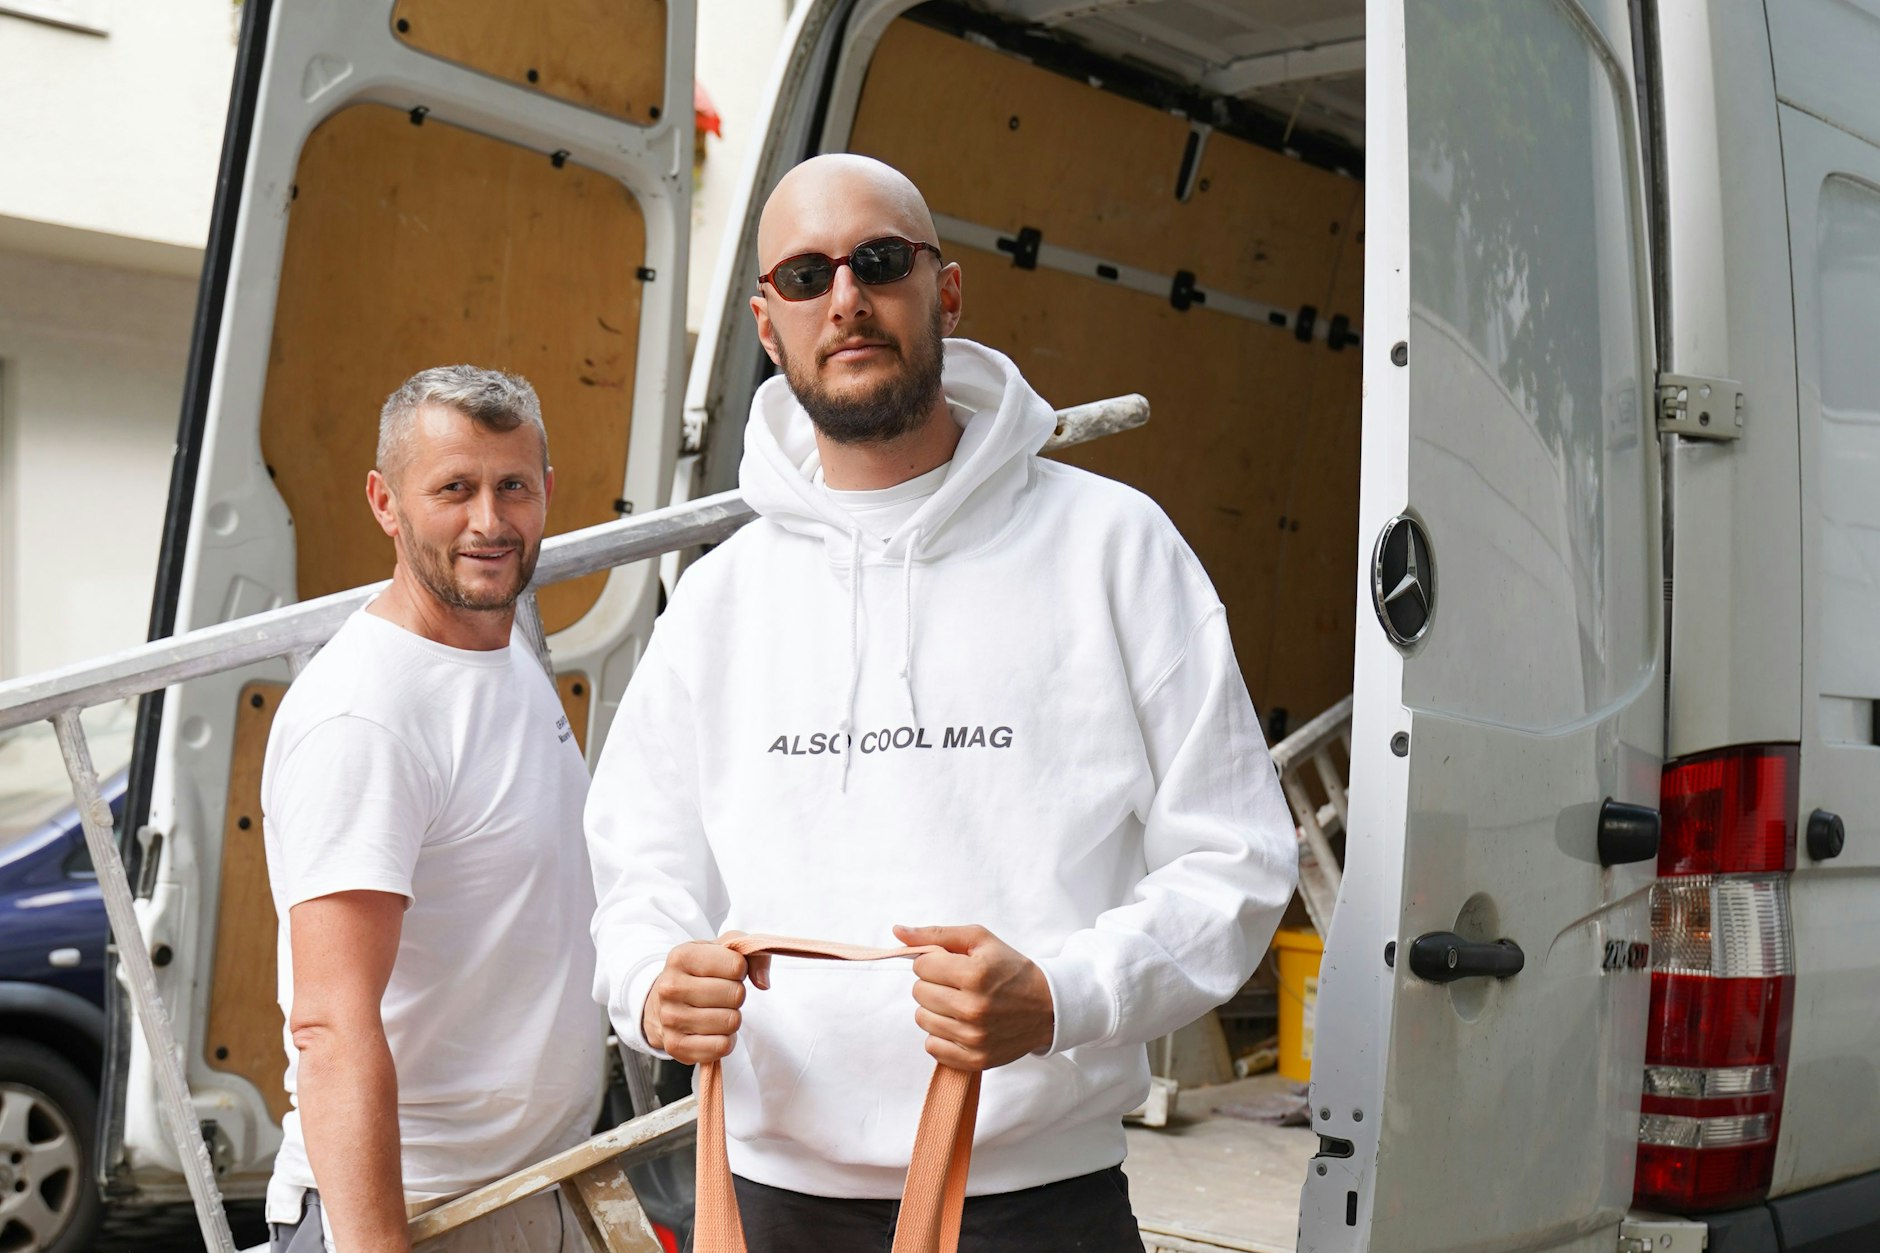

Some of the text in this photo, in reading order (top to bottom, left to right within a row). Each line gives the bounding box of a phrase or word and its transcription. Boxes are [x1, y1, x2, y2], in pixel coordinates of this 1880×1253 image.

[768, 725, 1014, 755] ALSO COOL MAG
